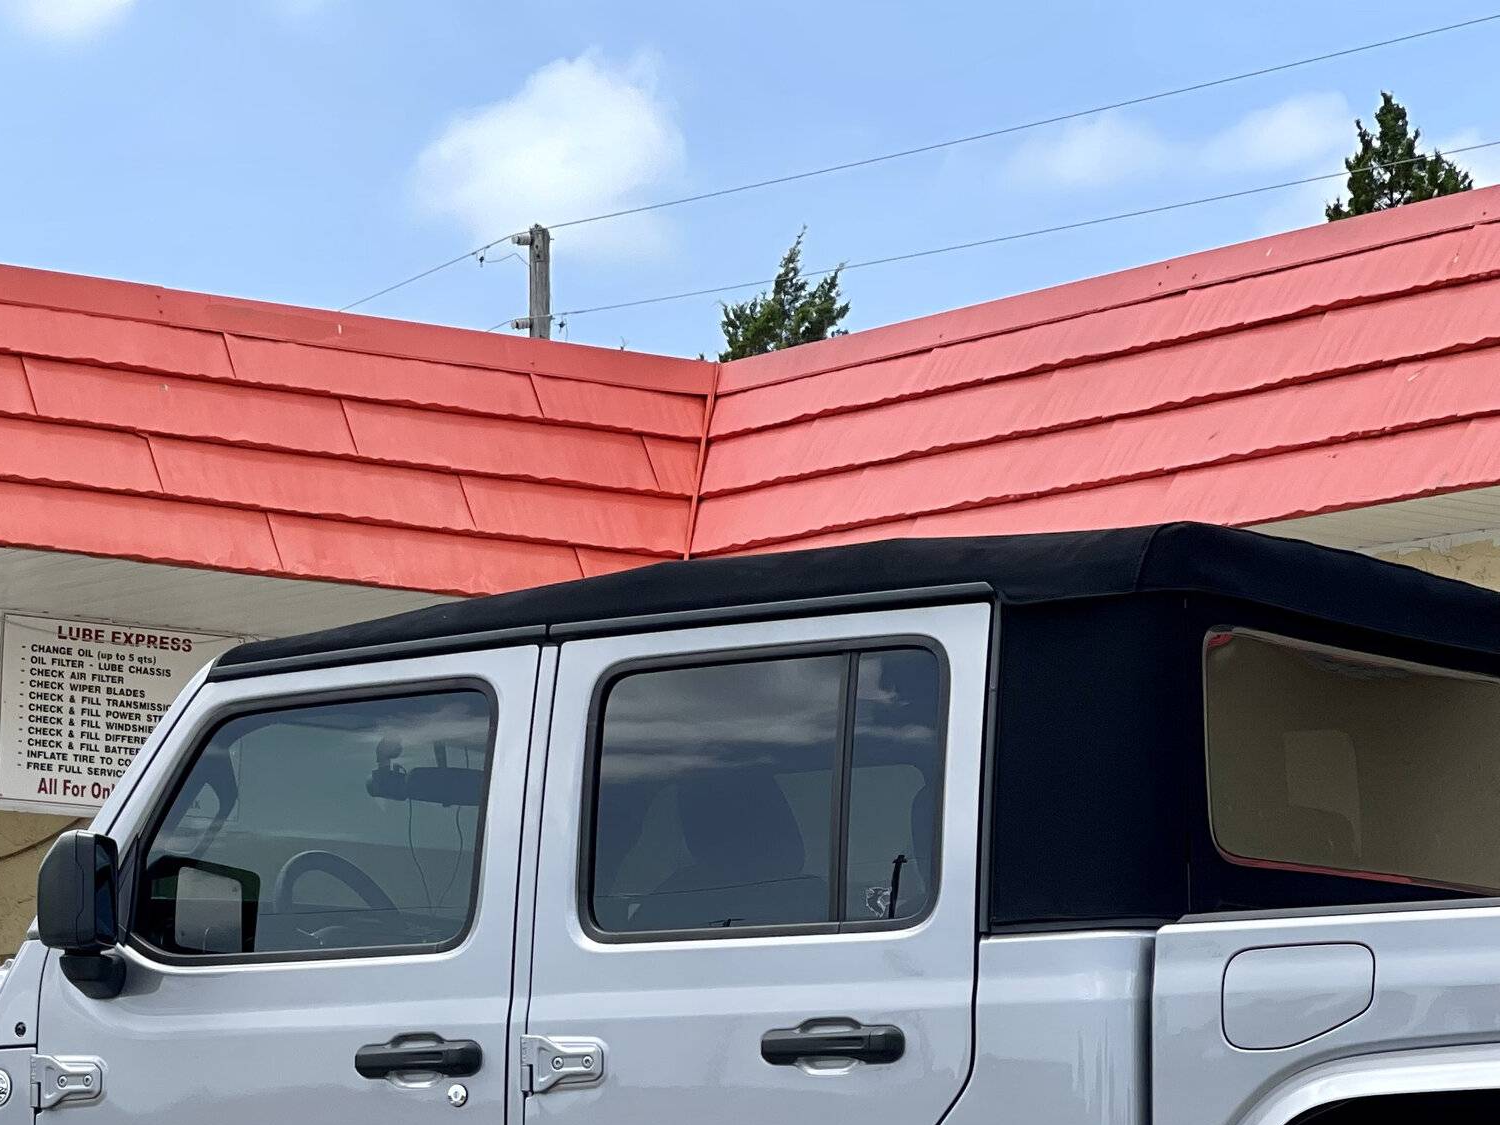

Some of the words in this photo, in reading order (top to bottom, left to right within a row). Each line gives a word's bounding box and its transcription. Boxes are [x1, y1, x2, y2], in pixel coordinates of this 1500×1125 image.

[58, 625, 105, 643] LUBE
[111, 631, 193, 653] EXPRESS
[31, 644, 73, 656] CHANGE
[78, 648, 94, 658] OIL
[97, 651, 113, 661] (up
[116, 652, 125, 661] to
[128, 653, 135, 662] 5
[137, 655, 157, 666] qts)
[30, 656, 46, 665] OIL
[51, 657, 85, 669] FILTER
[98, 662, 124, 673] LUBE
[128, 665, 172, 677] CHASSIS
[29, 667, 65, 679] CHECK
[70, 671, 87, 681] AIR
[91, 673, 125, 684] FILTER
[29, 679, 65, 690] CHECK
[70, 682, 101, 694] WIPER
[106, 686, 146, 699] BLADES
[28, 691, 64, 702] CHECK
[69, 694, 76, 704] &
[81, 695, 102, 706] FILL
[28, 703, 64, 714] CHECK
[68, 706, 75, 715] &
[81, 707, 101, 717] FILL
[105, 710, 141, 721] POWER
[28, 714, 63, 725] CHECK
[68, 718, 75, 727] &
[80, 719, 101, 729] FILL
[27, 726, 63, 737] CHECK
[67, 729, 74, 738] &
[80, 730, 100, 741] FILL
[27, 738, 63, 749] CHECK
[67, 741, 74, 750] &
[80, 742, 100, 753] FILL
[27, 750, 68, 761] INFLATE
[73, 753, 95, 764] TIRE
[100, 756, 113, 765] TO
[26, 761, 53, 772] FREE
[58, 764, 82, 774] FULL
[87, 767, 125, 778] SERVIC
[38, 777, 58, 795] All
[63, 779, 87, 798] For
